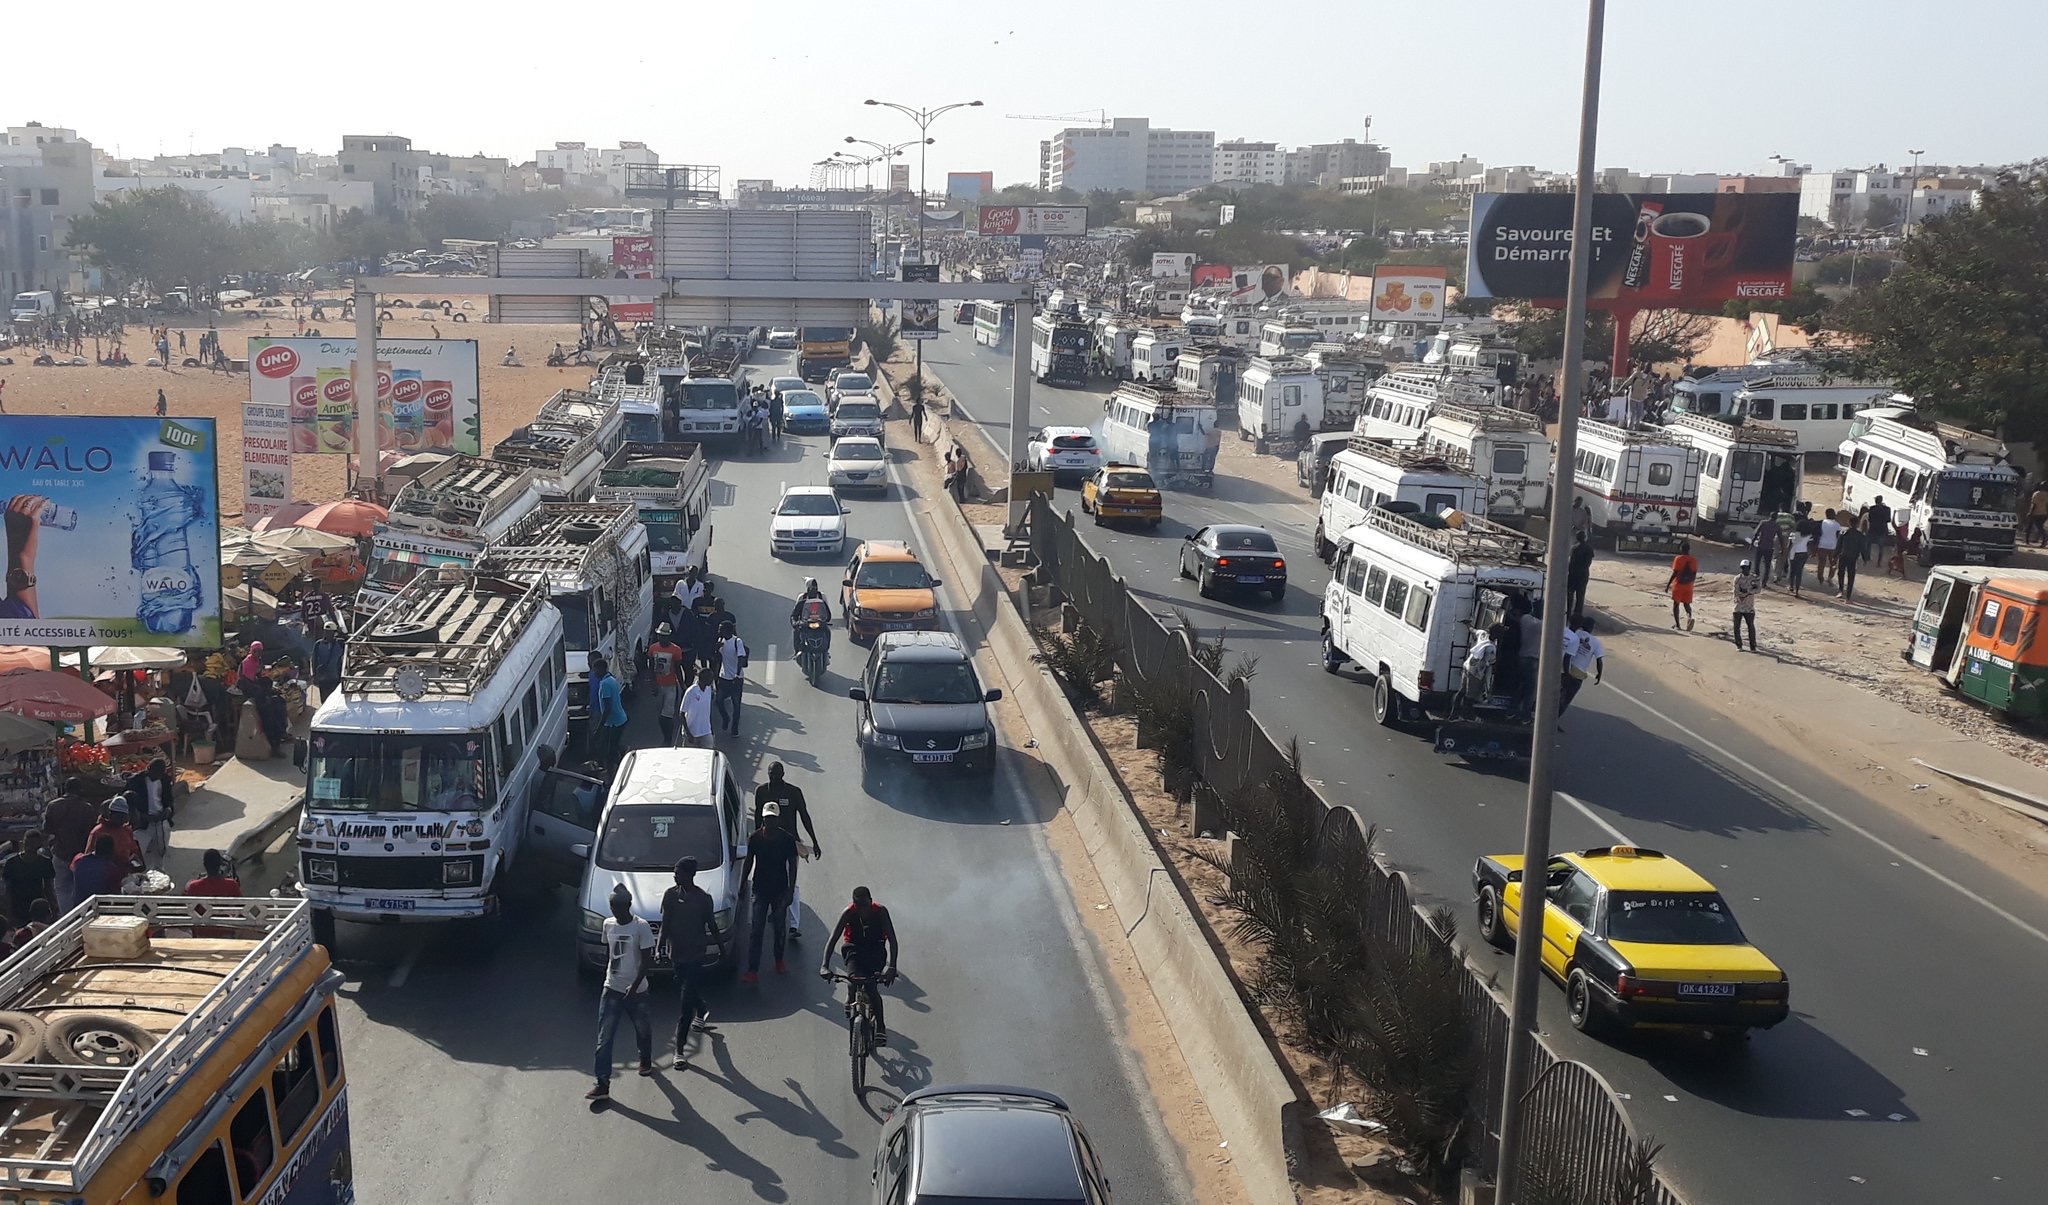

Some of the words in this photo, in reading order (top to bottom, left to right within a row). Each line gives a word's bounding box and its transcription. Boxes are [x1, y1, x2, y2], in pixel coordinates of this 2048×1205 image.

[988, 208, 1014, 221] Good
[983, 217, 1014, 233] knight
[1495, 226, 1574, 242] Savoure
[1593, 227, 1612, 242] Et
[1736, 282, 1786, 297] NESCAFÉ
[320, 342, 341, 354] Des
[377, 345, 432, 357] ceptionnels
[261, 351, 291, 367] UNO
[328, 382, 350, 395] UNO
[395, 382, 418, 396] UNO
[428, 392, 449, 404] UNO
[265, 407, 285, 419] SCOLAIRE
[166, 426, 198, 446] 100F
[243, 437, 288, 451] PRESCOLAIRE
[0, 446, 114, 473] WALO
[244, 451, 289, 466] ELEMENTAIRE
[380, 539, 419, 551] TALIBE
[146, 579, 187, 591] WALO
[306, 601, 321, 615] 23
[24, 627, 86, 638] ACCESSIBLE
[99, 629, 127, 639] TOUS
[34, 710, 56, 718] Kash
[61, 710, 83, 718] Kash
[338, 821, 387, 838] ALHAMD
